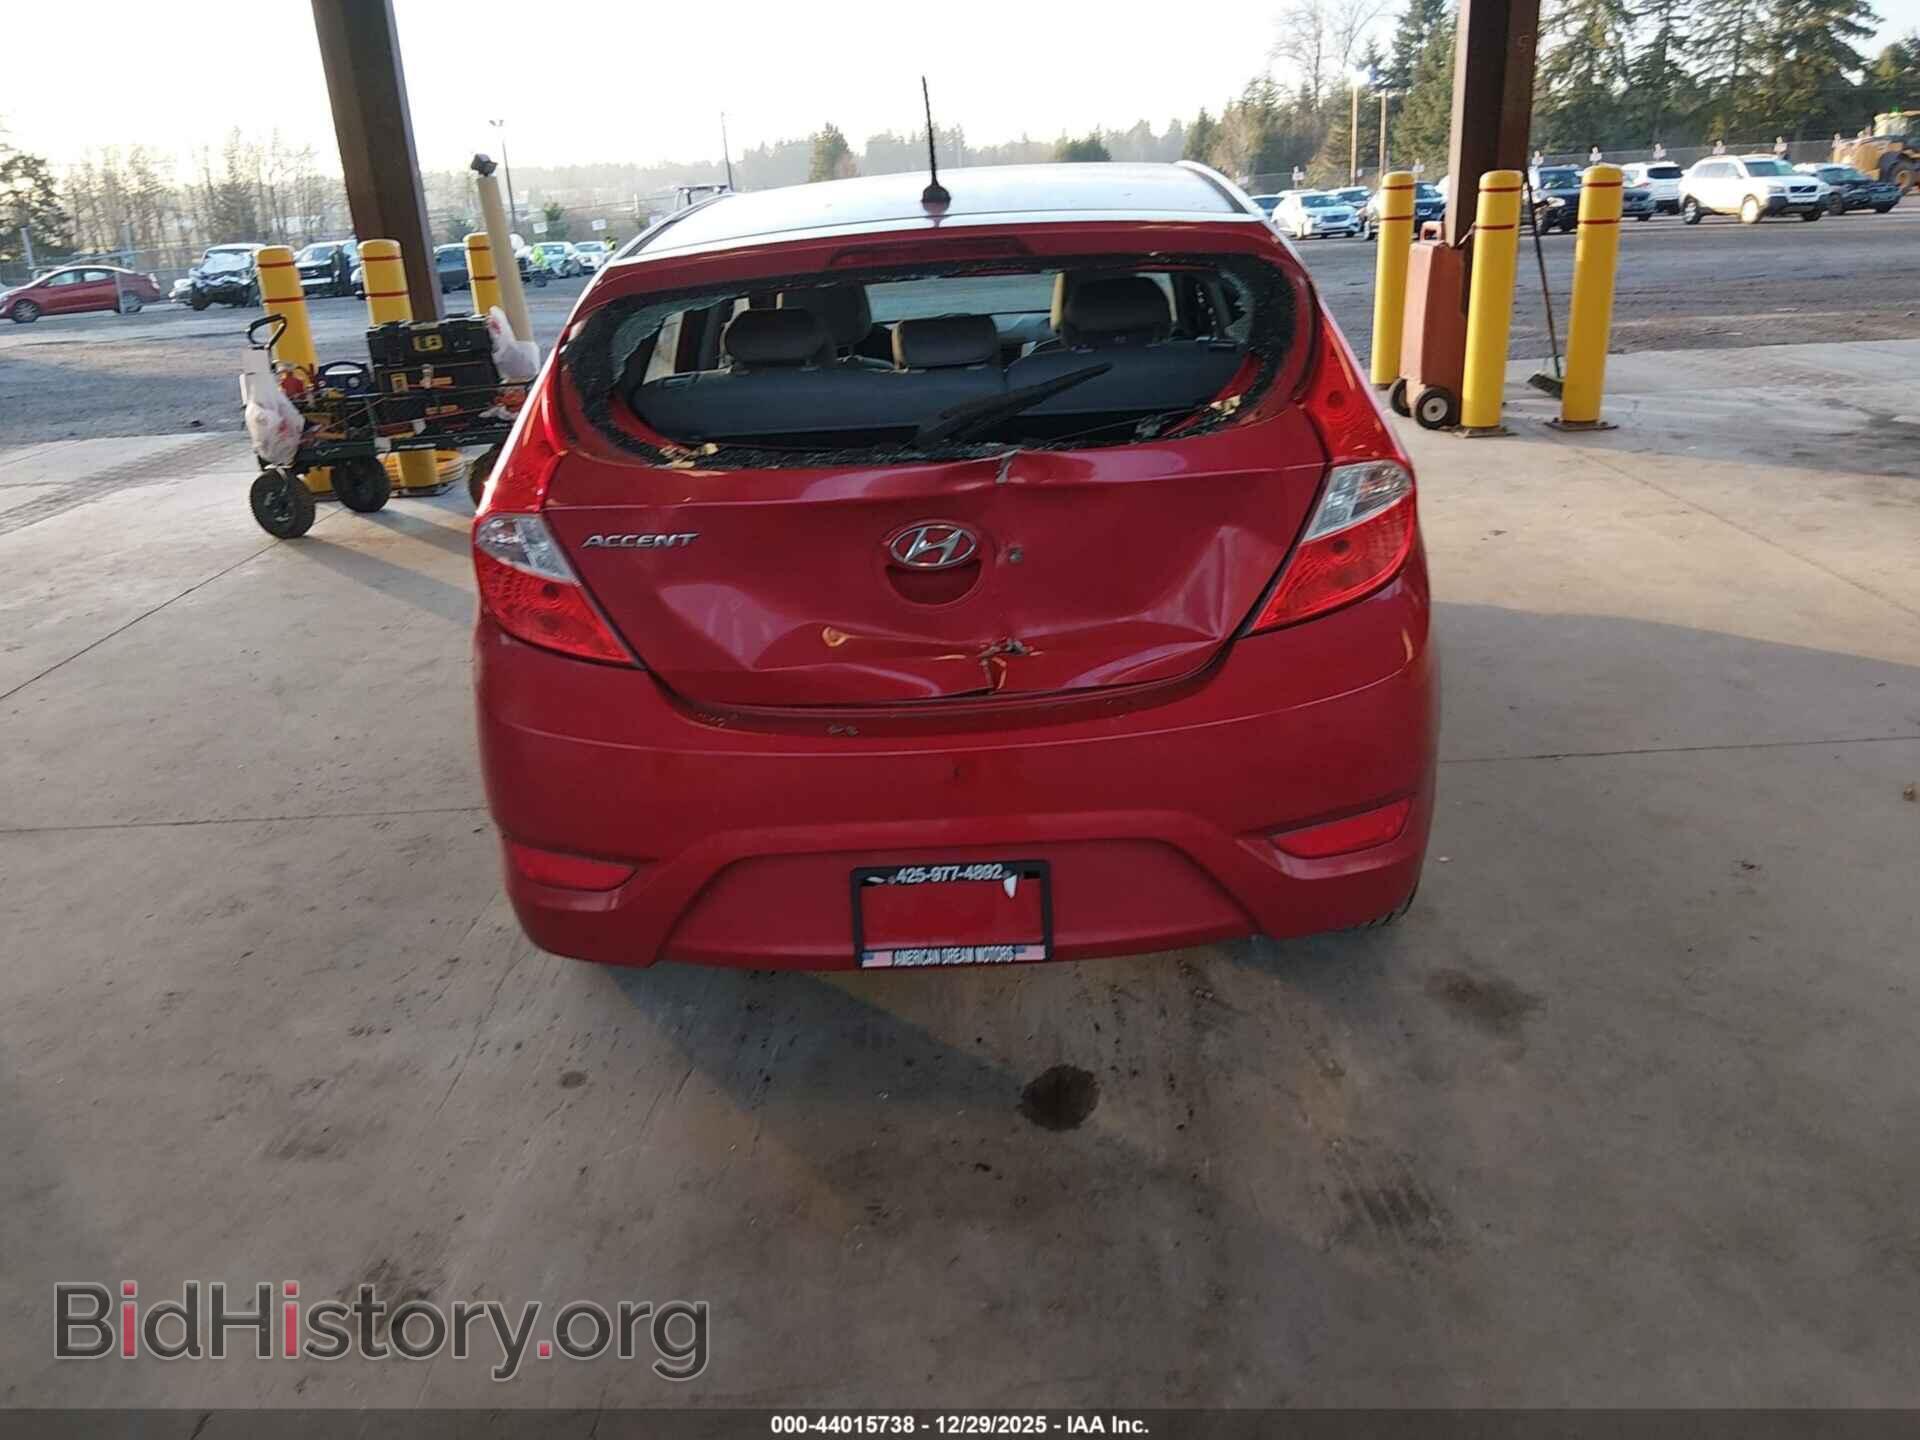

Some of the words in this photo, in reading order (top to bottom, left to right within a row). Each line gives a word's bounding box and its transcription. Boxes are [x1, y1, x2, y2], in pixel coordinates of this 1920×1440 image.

[582, 532, 699, 548] ACCENT
[894, 948, 941, 966] AMERICAN
[975, 945, 1015, 963] MOTORS
